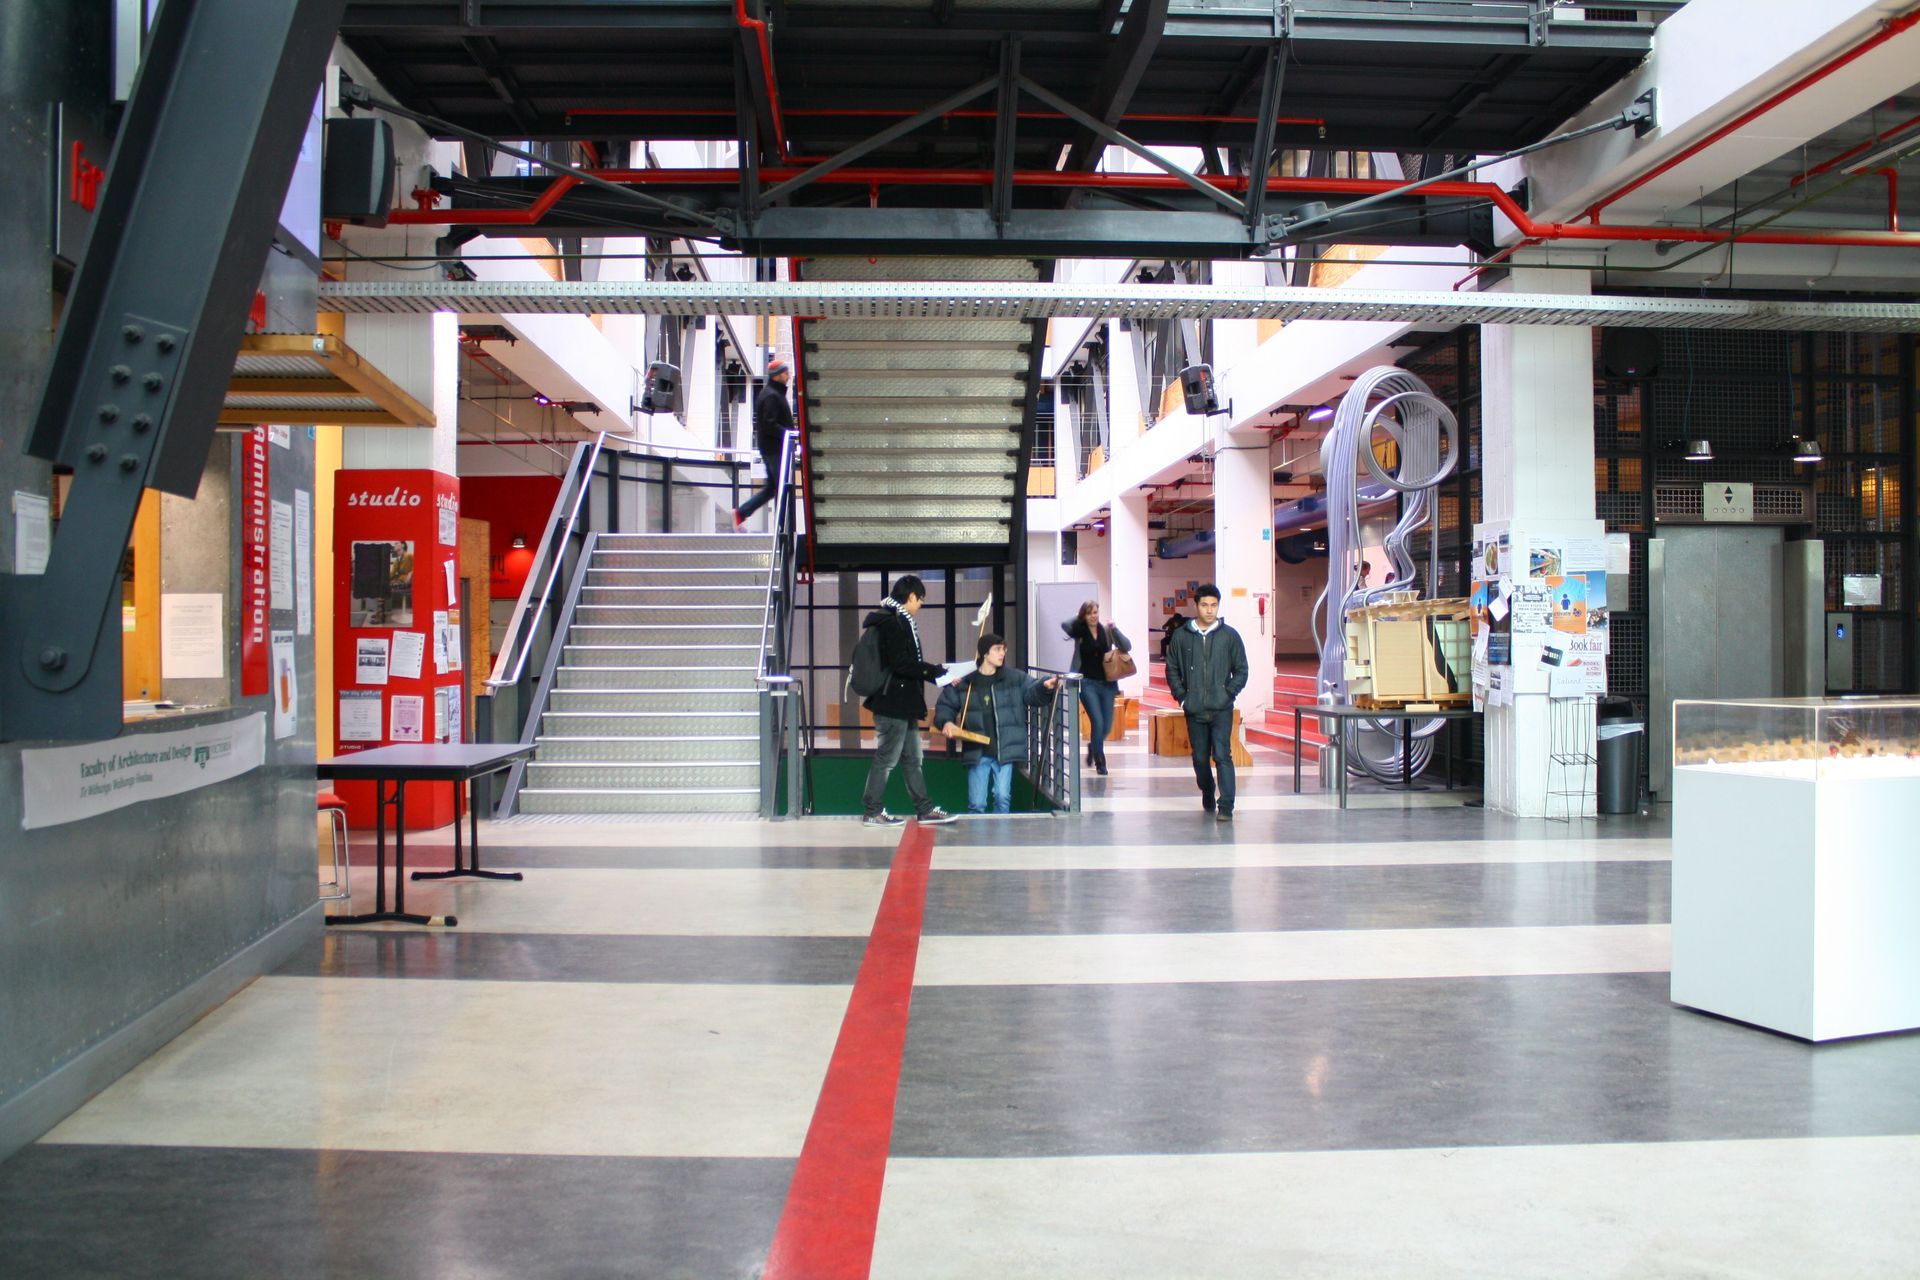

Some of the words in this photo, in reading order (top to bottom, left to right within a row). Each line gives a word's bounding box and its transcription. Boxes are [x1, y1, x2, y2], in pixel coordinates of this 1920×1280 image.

[347, 486, 422, 507] studio
[436, 491, 459, 512] studio
[253, 426, 268, 644] Administration
[1589, 639, 1602, 651] fair
[80, 757, 107, 778] Faculty
[107, 752, 117, 772] of
[117, 749, 158, 770] Architecture
[159, 745, 172, 763] and
[172, 744, 192, 762] Design
